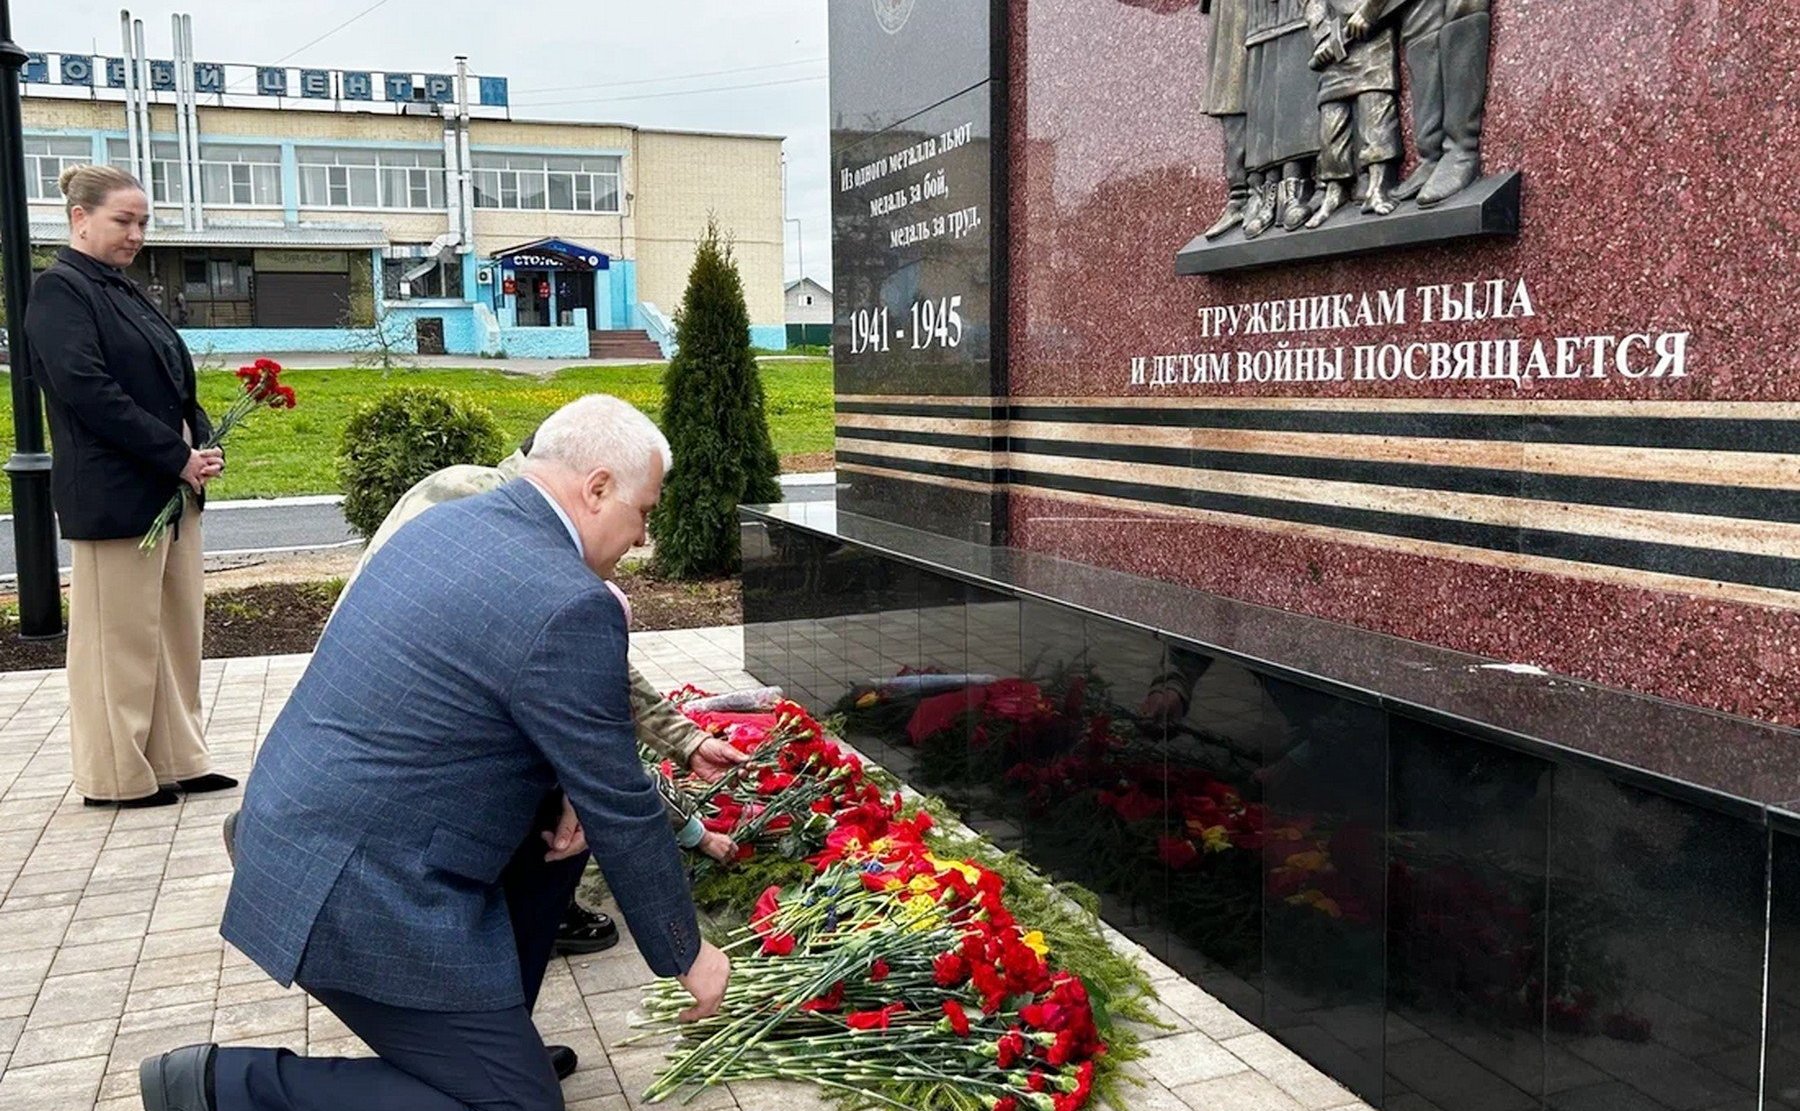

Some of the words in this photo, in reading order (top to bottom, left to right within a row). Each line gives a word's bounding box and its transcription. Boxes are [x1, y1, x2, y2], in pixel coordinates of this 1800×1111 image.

[263, 67, 447, 94] ЦЕНТР
[841, 167, 853, 192] Из
[854, 158, 888, 188] одного
[889, 138, 936, 173] металла
[938, 121, 972, 154] льют
[870, 189, 907, 218] медаль
[909, 183, 921, 204] за
[923, 168, 949, 199] бой,
[890, 221, 930, 248] медаль
[931, 216, 945, 237] за
[947, 206, 981, 239] труд.
[850, 305, 890, 354] 1941
[911, 295, 962, 349] 1945
[1198, 288, 1406, 337] ТРУЖЕНИКАМ
[1417, 276, 1535, 323] ТЫЛА
[1131, 356, 1145, 385] И
[1150, 351, 1231, 389] ДЕТЯМ
[1237, 340, 1345, 383] ВОЙНЫ
[1353, 331, 1690, 388] ПОСВЯЩАЕТСЯ
